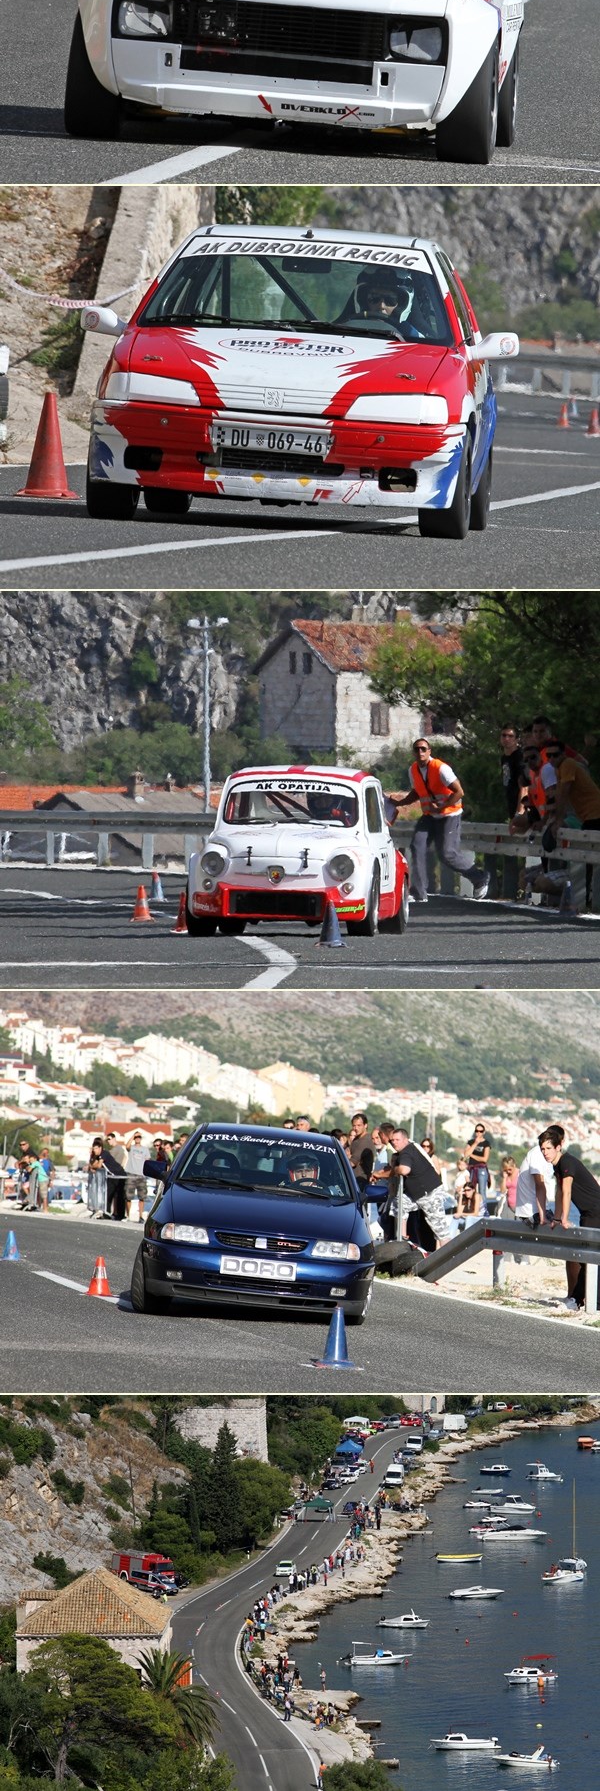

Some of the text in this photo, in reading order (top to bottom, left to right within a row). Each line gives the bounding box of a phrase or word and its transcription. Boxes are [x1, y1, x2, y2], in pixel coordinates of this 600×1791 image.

[192, 242, 420, 267] AK DUBROVNIK RACING
[231, 429, 322, 453] DU 069-46
[278, 784, 330, 792] OPATIJA
[240, 1135, 277, 1146] Racing
[278, 1139, 303, 1148] team
[303, 1142, 336, 1155] PAZIN
[223, 1258, 294, 1278] DORO
